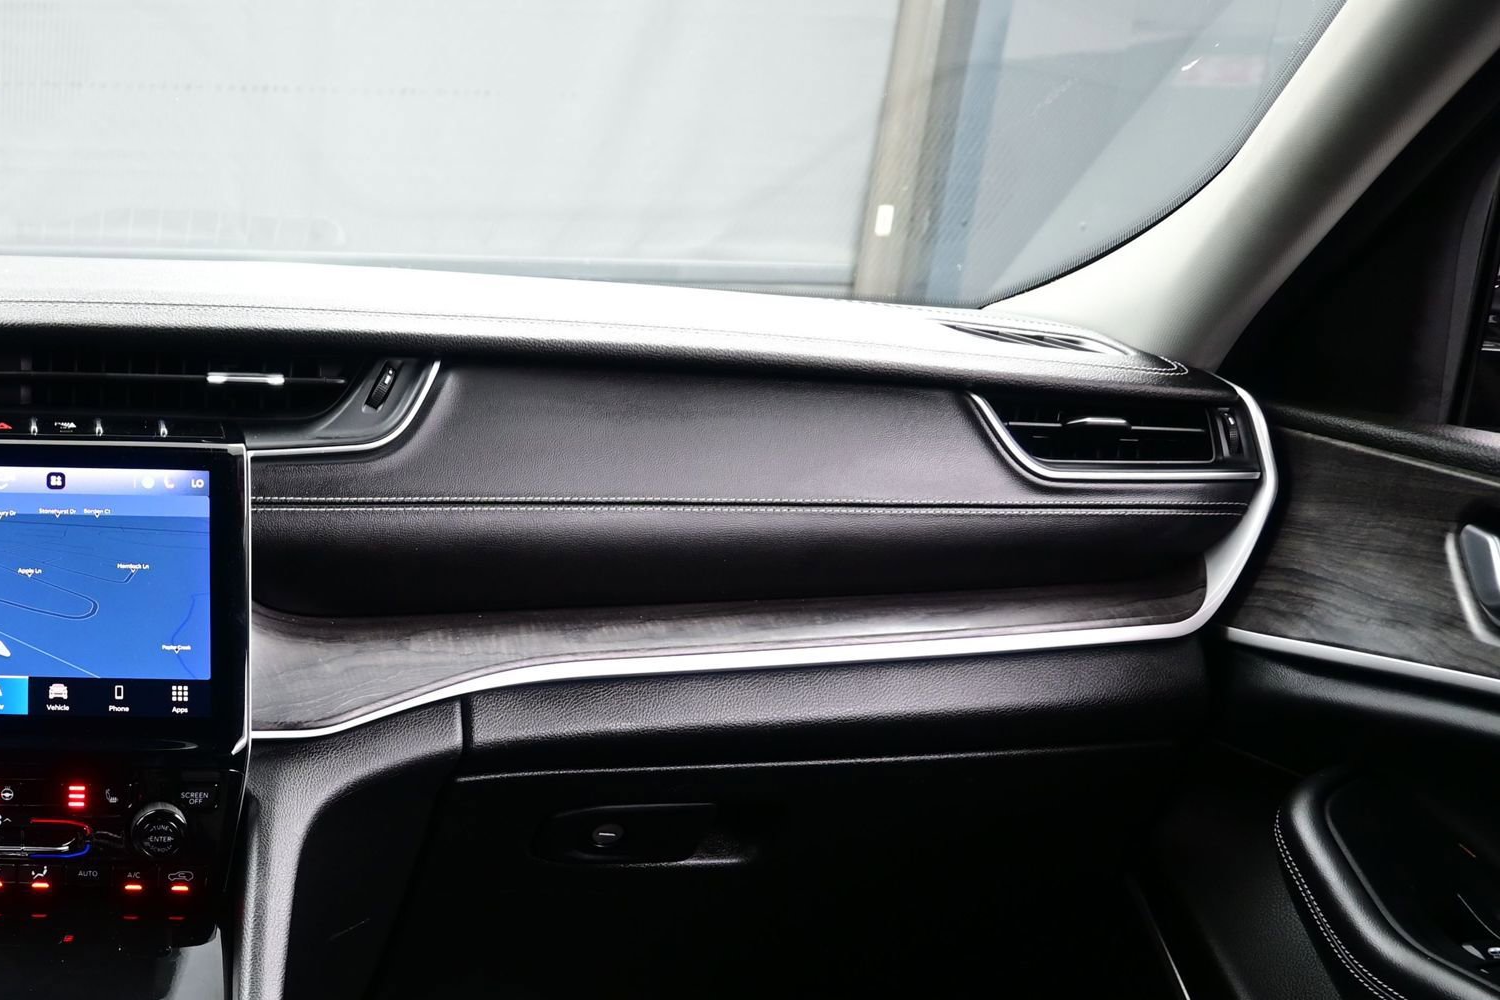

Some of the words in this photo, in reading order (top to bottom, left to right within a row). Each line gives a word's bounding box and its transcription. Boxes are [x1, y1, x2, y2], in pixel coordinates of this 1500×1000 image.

[190, 478, 205, 488] LO
[34, 567, 42, 575] Ln
[46, 703, 70, 711] Vehicle
[108, 705, 130, 713] Phone
[171, 706, 189, 715] Apps
[180, 791, 209, 799] SCREEN
[149, 835, 172, 843] ENTER
[126, 871, 141, 879] A/C
